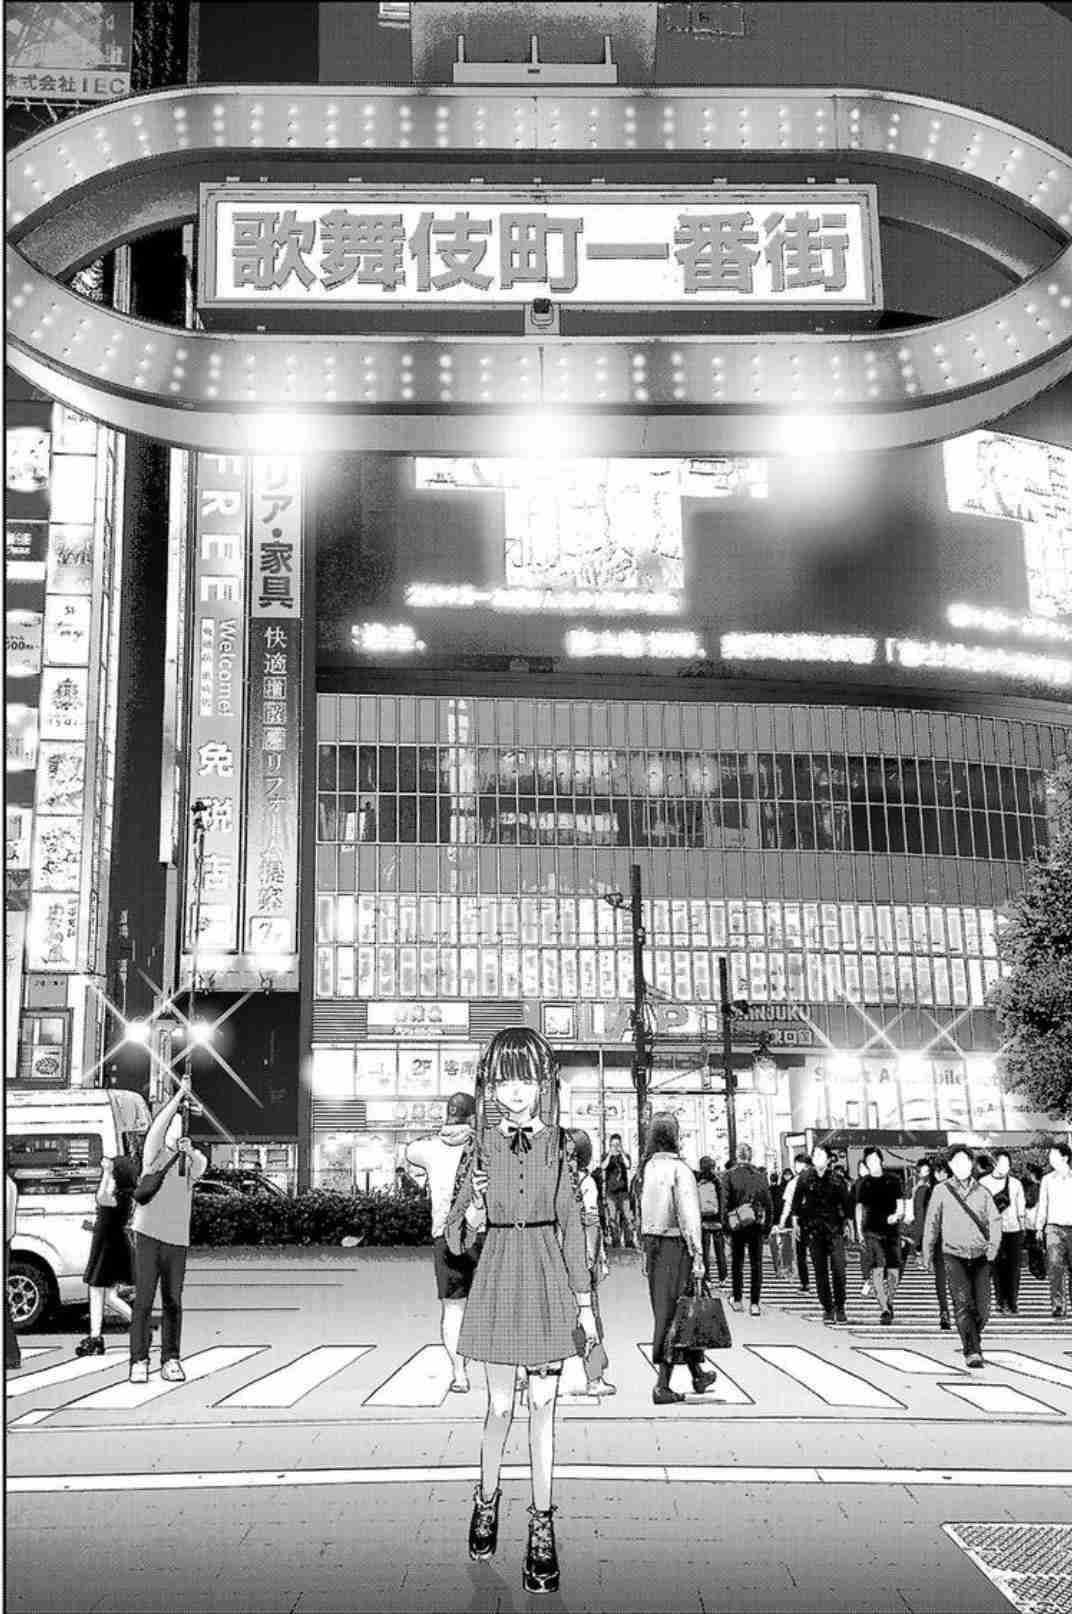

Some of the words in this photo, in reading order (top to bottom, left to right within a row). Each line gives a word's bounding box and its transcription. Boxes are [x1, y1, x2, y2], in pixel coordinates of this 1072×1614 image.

[231, 209, 849, 293] 歌舞伎町一番街
[218, 618, 237, 717] Welcome!
